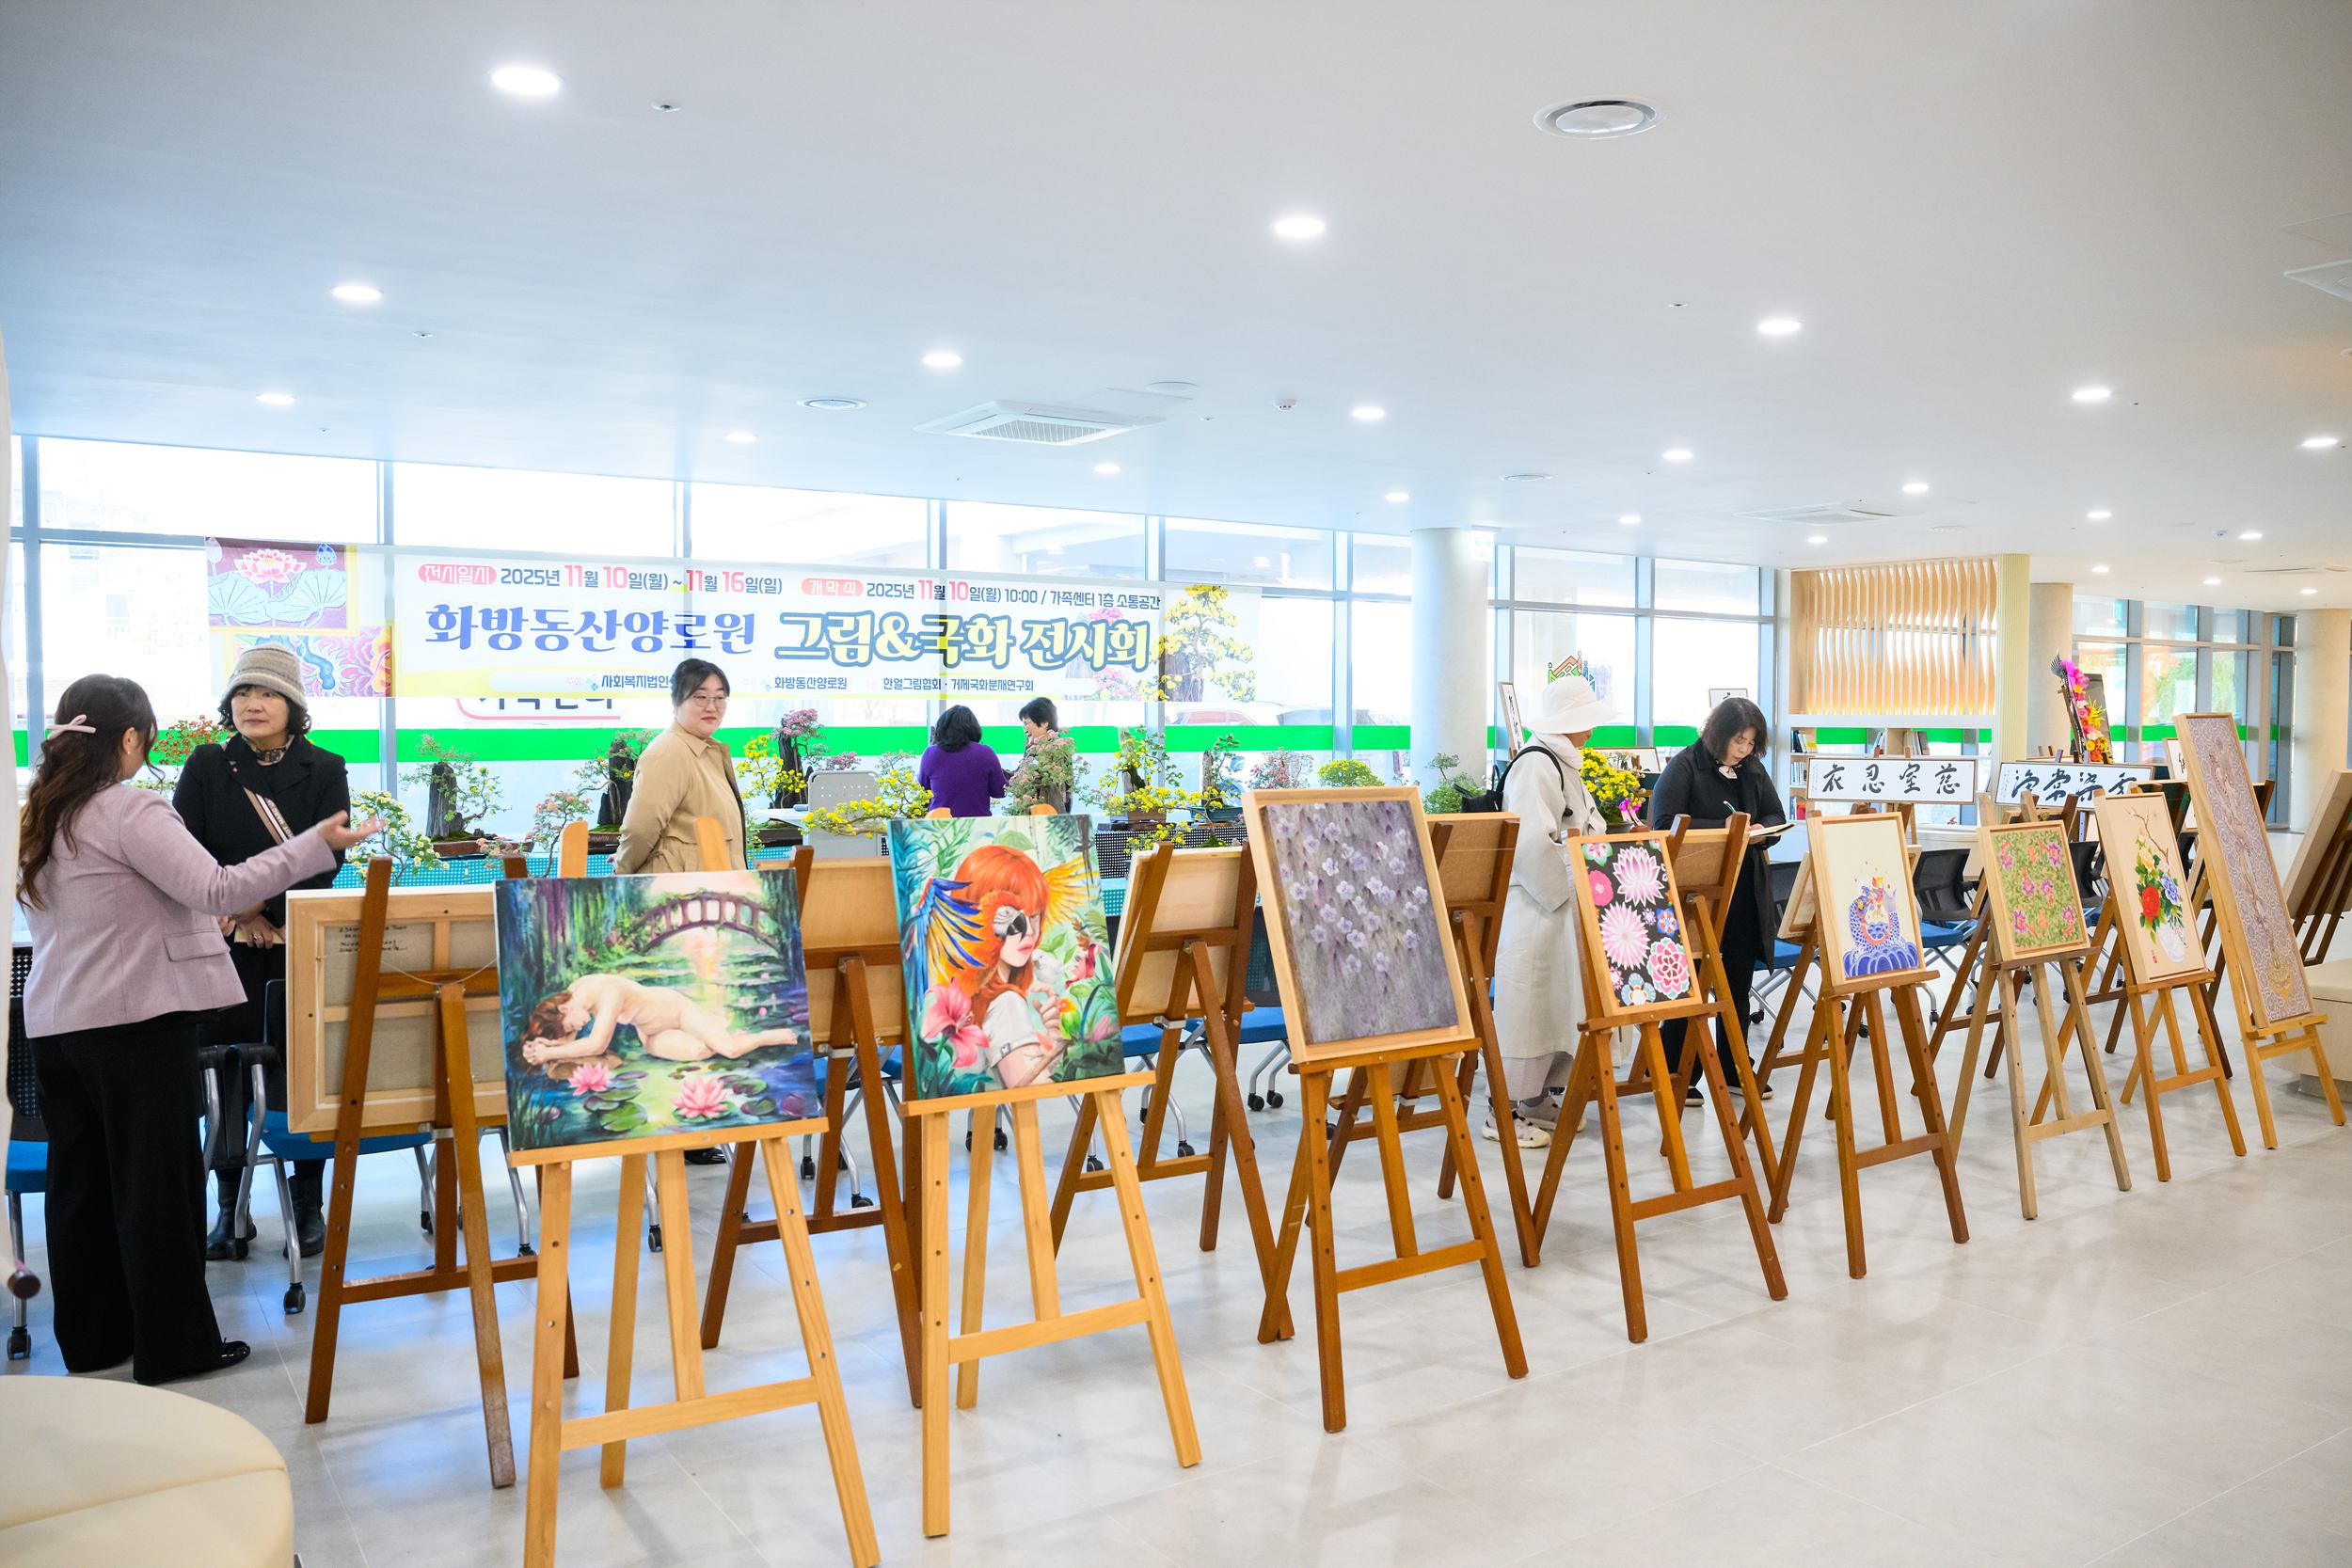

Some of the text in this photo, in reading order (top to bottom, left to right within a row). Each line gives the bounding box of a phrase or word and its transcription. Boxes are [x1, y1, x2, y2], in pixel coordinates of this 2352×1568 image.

[423, 564, 490, 585] 전시일시
[501, 568, 560, 586] 2025년
[564, 564, 599, 588] 11월
[603, 566, 668, 590] 10일(월)
[686, 569, 717, 592] 11월
[722, 571, 782, 594] 16일(일)
[866, 582, 914, 599] 2025년
[918, 579, 946, 601] 11월
[949, 581, 1001, 603] 10일(월)
[1005, 588, 1038, 603] 10:00
[1050, 591, 1094, 607] 가족센터
[1099, 593, 1114, 608] 1층
[1117, 594, 1160, 610] 소통공간
[425, 604, 1151, 673] 화방동산양로원 그림&국화 전시회
[601, 674, 669, 689] 사회복지법인
[774, 676, 847, 689] 화방동산양로원
[951, 678, 1034, 691] 거제국화분재연구회
